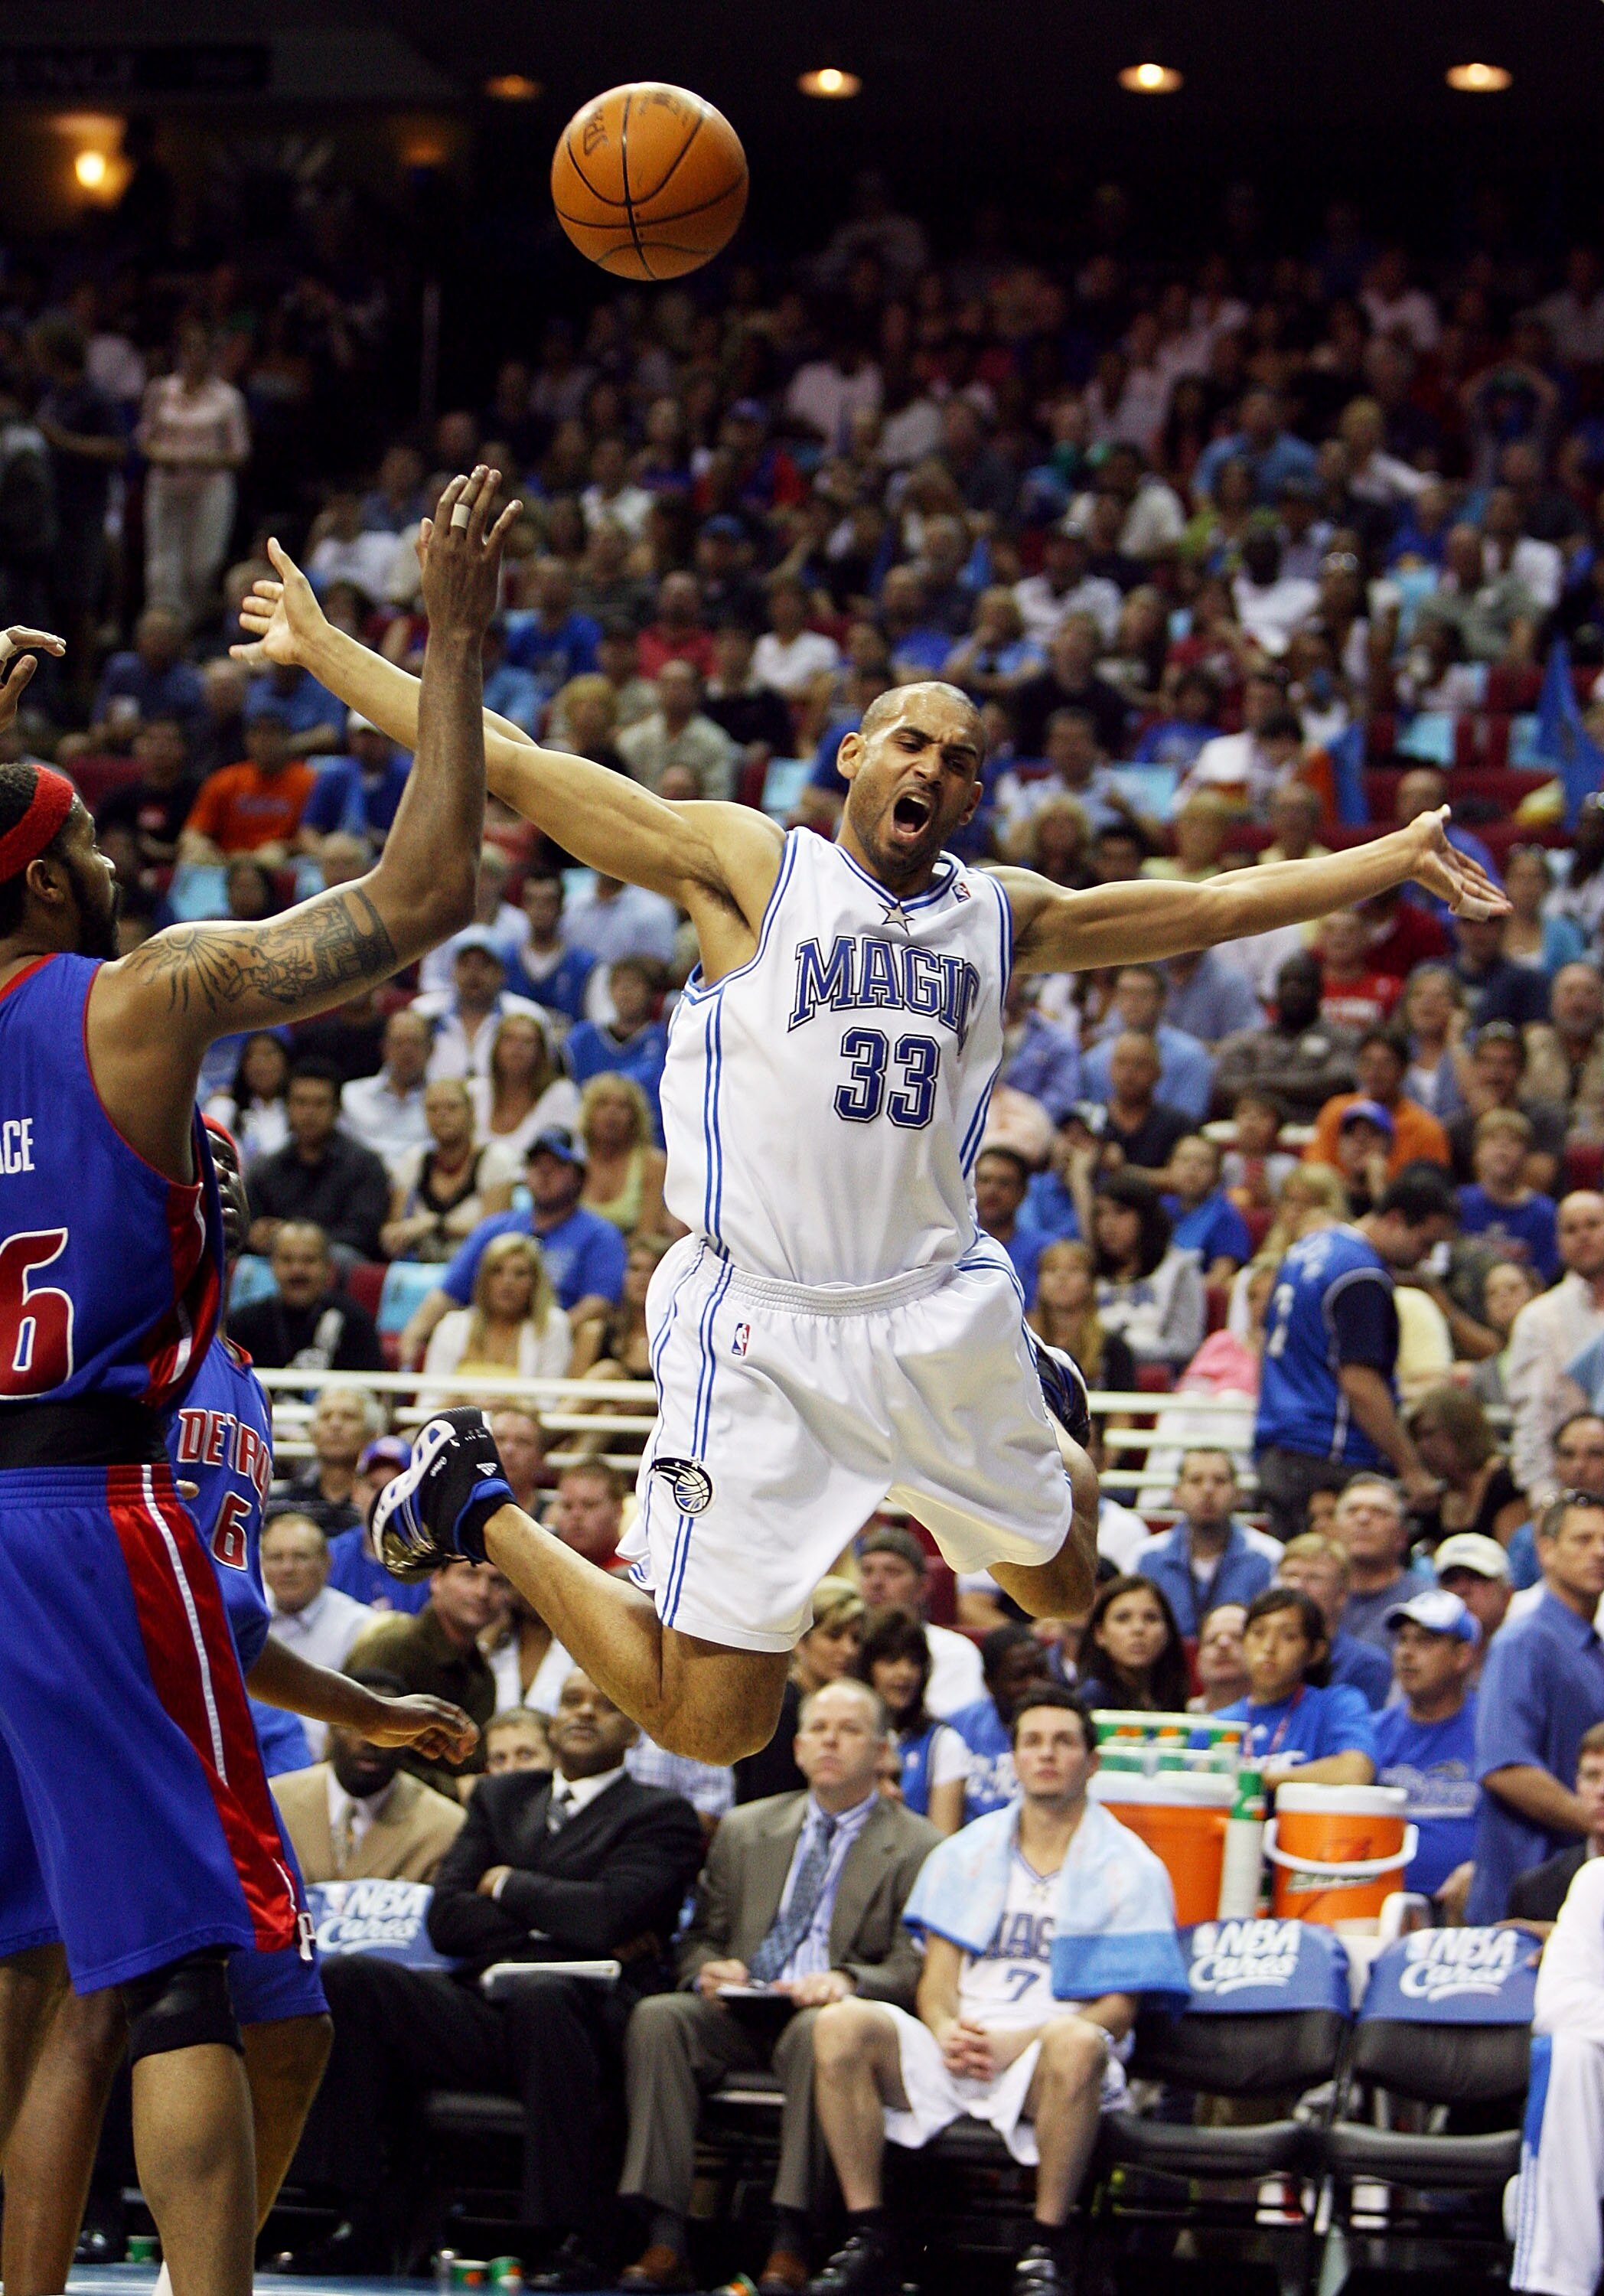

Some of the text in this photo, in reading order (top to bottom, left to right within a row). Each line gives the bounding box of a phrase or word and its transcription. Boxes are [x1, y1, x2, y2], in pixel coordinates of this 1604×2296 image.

[833, 1026, 941, 1130] 33
[210, 1491, 252, 1570] 6
[316, 1916, 422, 1952] Cares
[1215, 1919, 1301, 1957] NBA
[1430, 1926, 1518, 1967] NBA
[1006, 1968, 1040, 2001] 7
[1188, 1953, 1299, 1992] Cares
[1399, 1959, 1511, 1998] Cares
